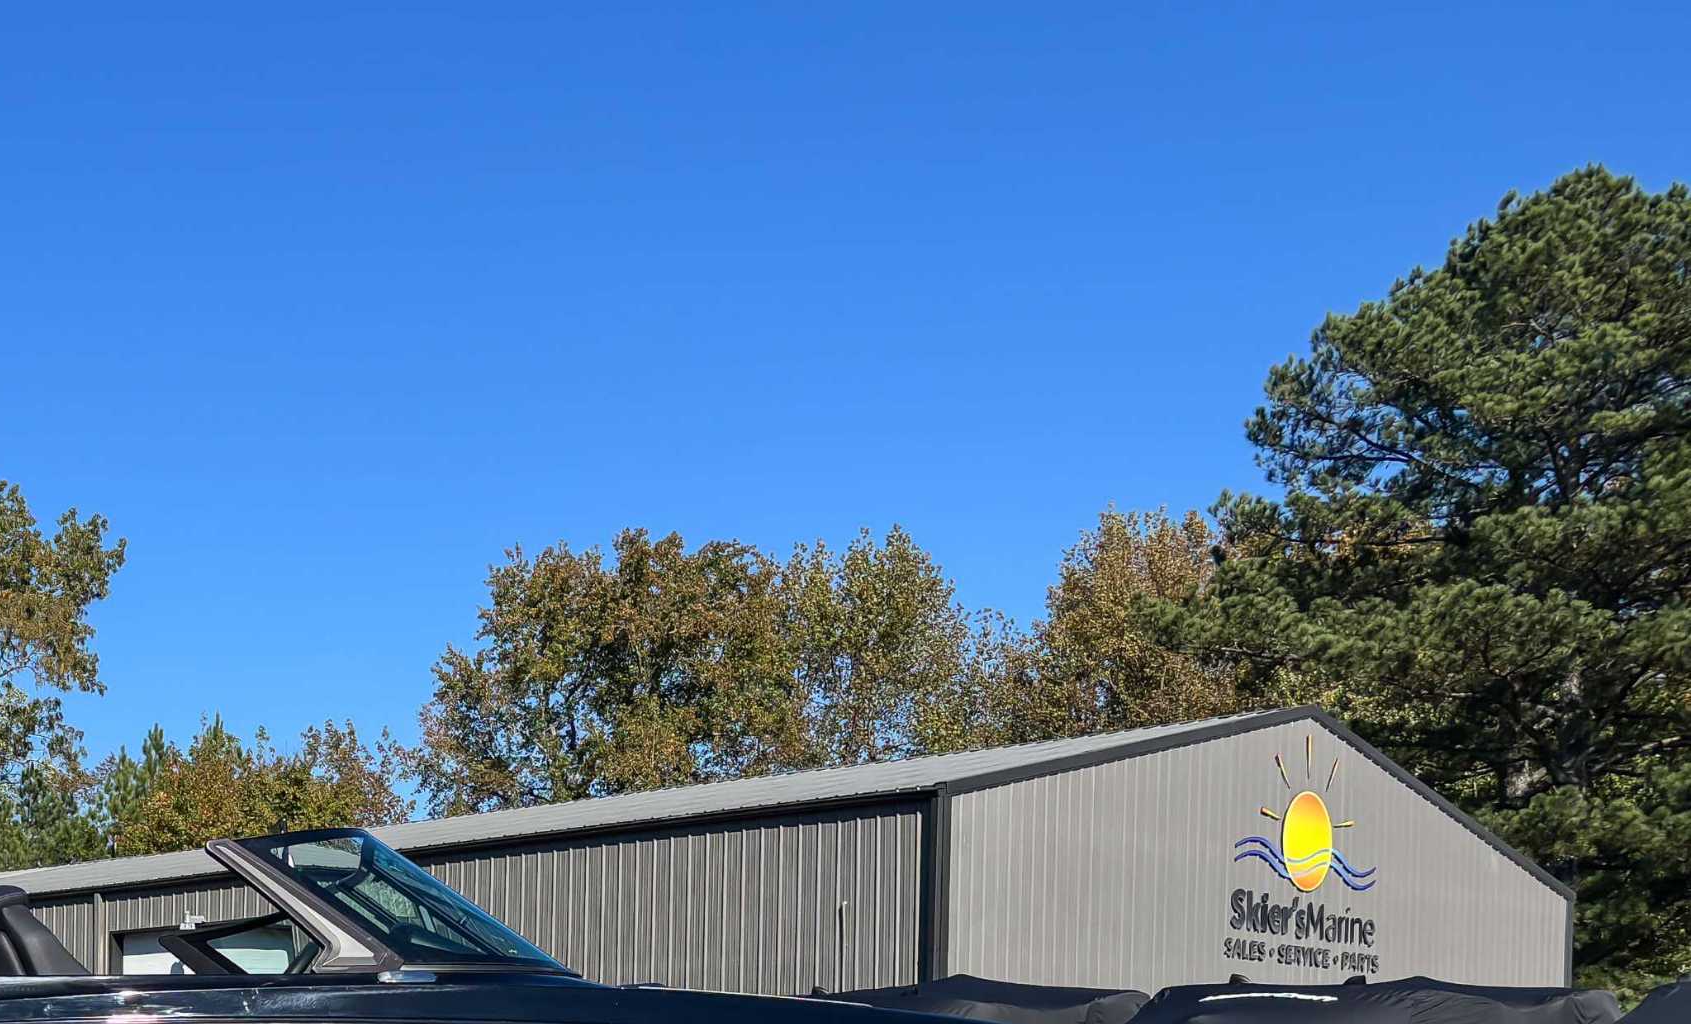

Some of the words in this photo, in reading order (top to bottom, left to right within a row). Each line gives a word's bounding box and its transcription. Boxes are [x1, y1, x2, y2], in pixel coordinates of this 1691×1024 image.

[1223, 937, 1266, 962] SALES
[1277, 943, 1331, 969] SERVICE
[1340, 951, 1380, 974] PARTS
